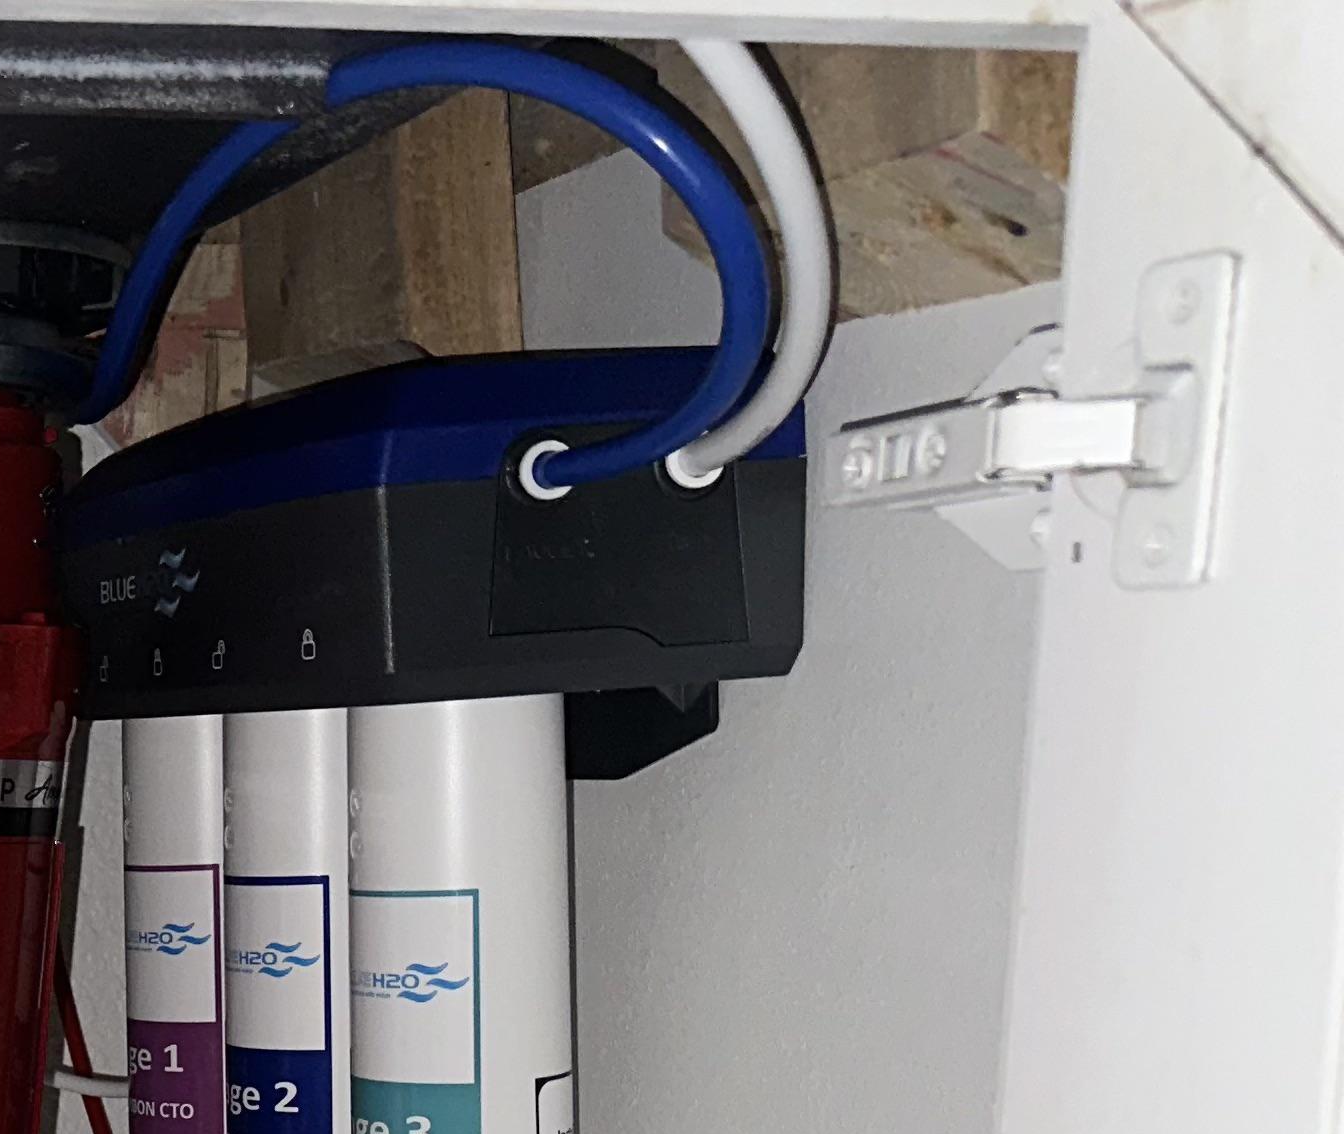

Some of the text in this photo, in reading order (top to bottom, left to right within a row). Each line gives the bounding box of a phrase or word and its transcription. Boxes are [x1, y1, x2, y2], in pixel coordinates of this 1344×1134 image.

[99, 575, 137, 605] BLUE
[164, 1044, 184, 1073] 1
[159, 1102, 195, 1120] CTO
[274, 1081, 299, 1113] 2
